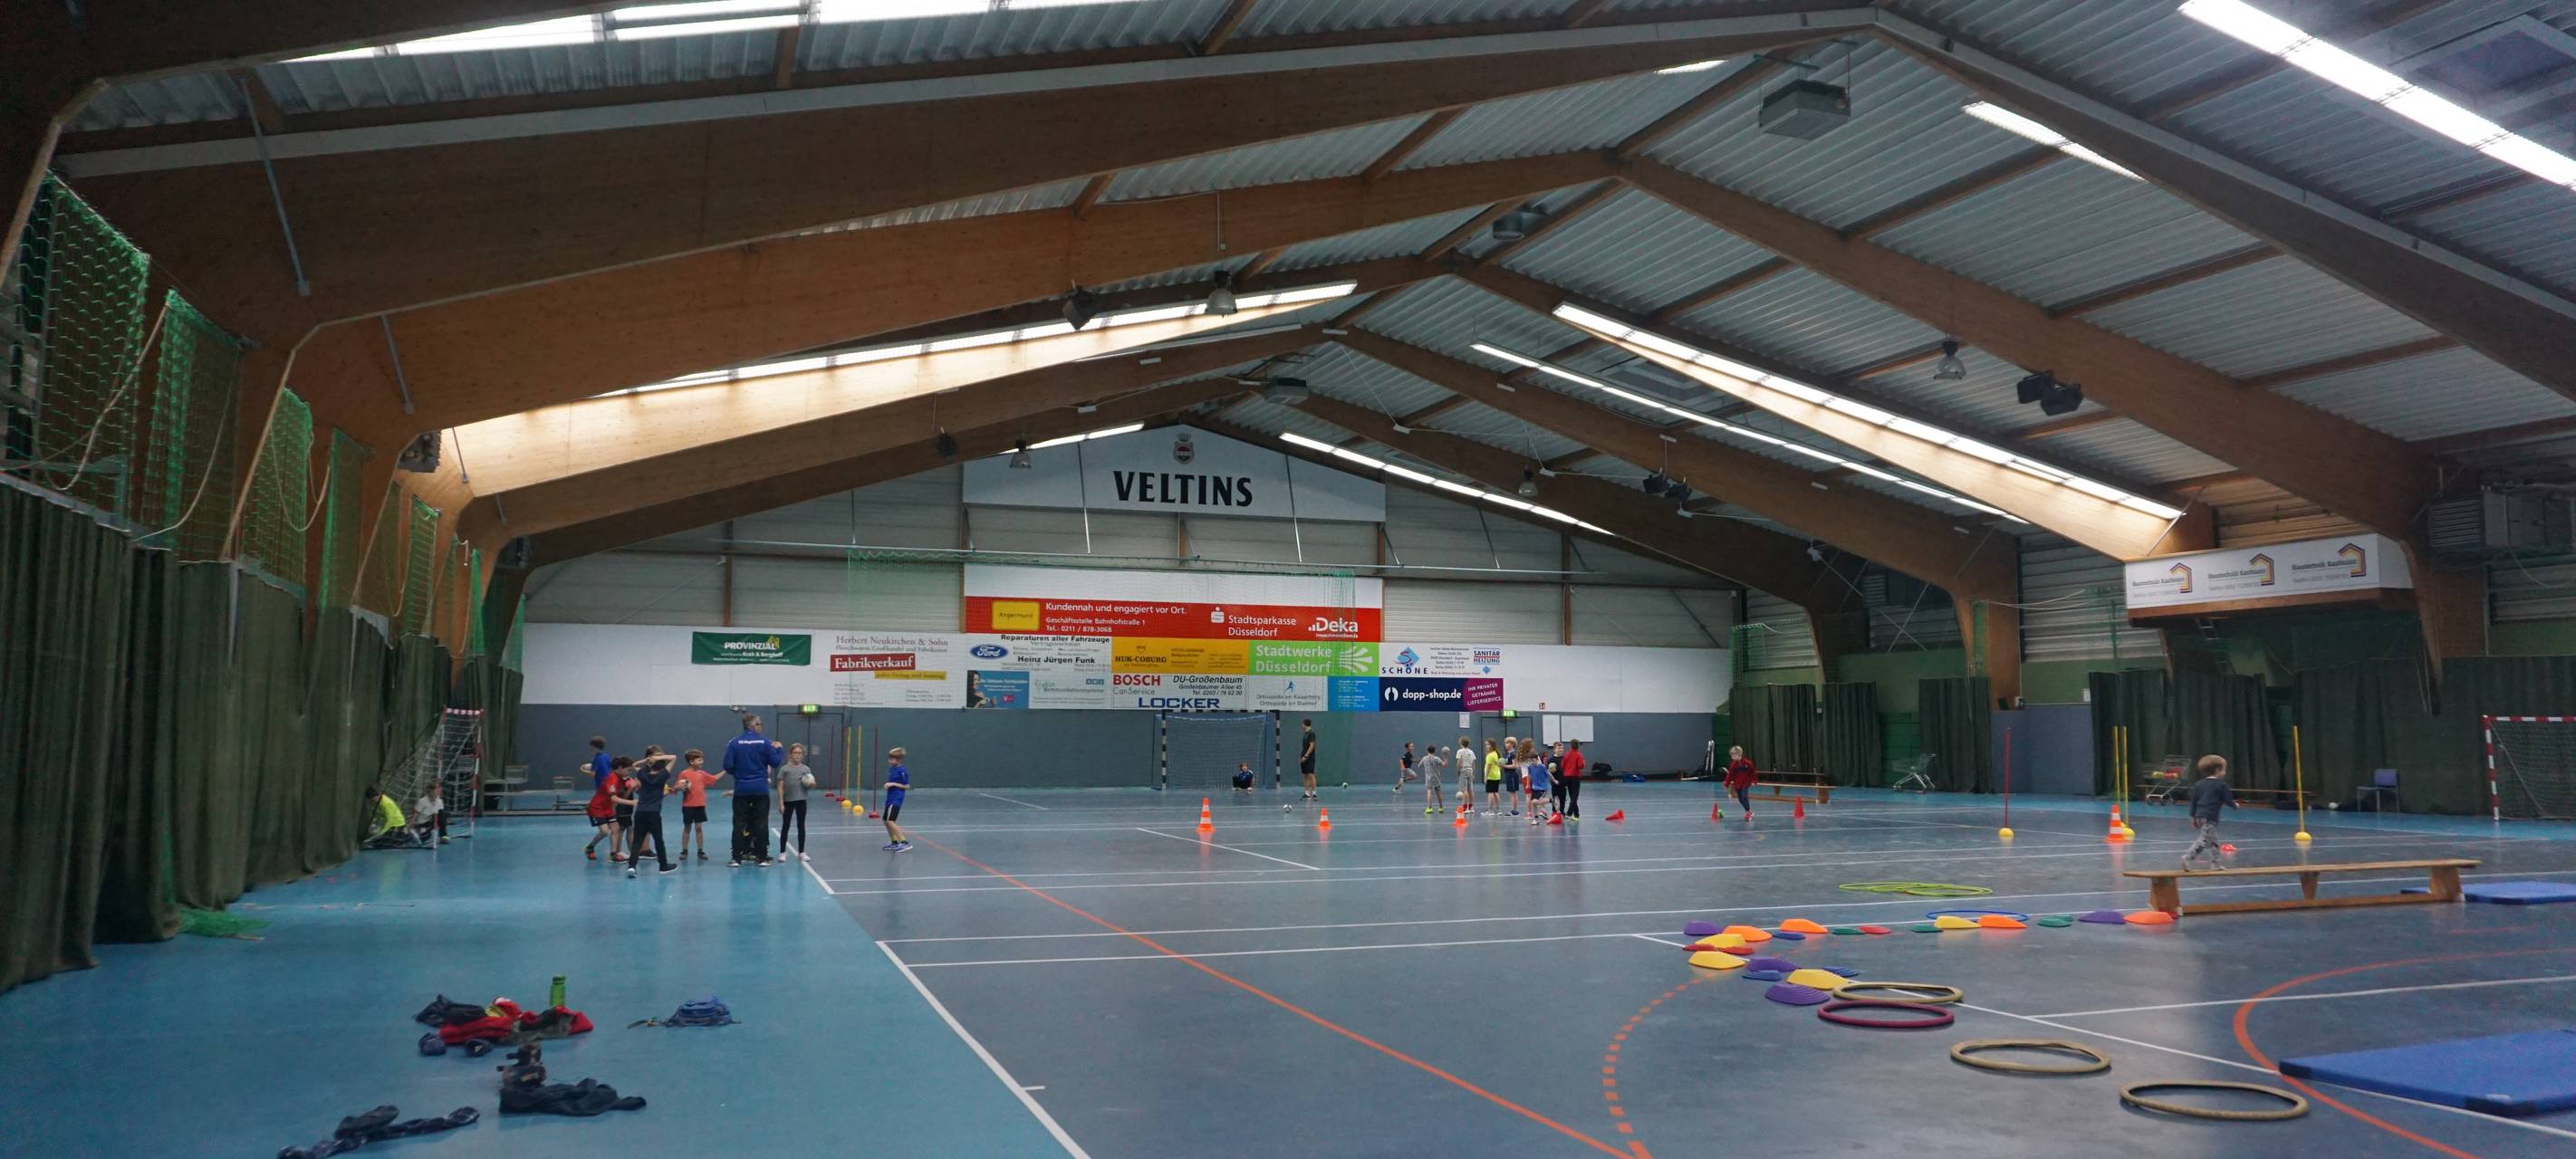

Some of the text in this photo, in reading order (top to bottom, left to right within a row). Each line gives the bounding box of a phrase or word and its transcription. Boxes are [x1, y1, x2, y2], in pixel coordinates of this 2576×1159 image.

[1113, 471, 1253, 507] VELTINS
[1045, 602, 1093, 611] Kundennah
[1096, 604, 1111, 612] und
[1114, 605, 1153, 614] engagiert
[1170, 606, 1187, 614] Ort.
[1094, 618, 1139, 626] Bahnhofstraße
[1228, 615, 1297, 626] Stadtsparkasse
[1316, 617, 1359, 632] Deka
[1228, 627, 1278, 637] Düsseldorf
[836, 636, 868, 645] Herbert
[870, 637, 915, 646] Neukirchen
[1071, 636, 1110, 644] Fahrzeuge
[725, 642, 776, 650] PROVINZIAL
[976, 646, 1000, 656] Ford
[1255, 645, 1332, 657] Stadtwerke
[835, 656, 914, 669] Fabrikverkauf
[1043, 656, 1072, 665] Jürgen
[1255, 660, 1331, 672] Düsseldorf
[1381, 664, 1427, 674] SCHÖNE
[1113, 675, 1161, 686] BOSCH
[1402, 689, 1462, 701] dopp-shop.de
[1138, 697, 1221, 708] LOCKER
